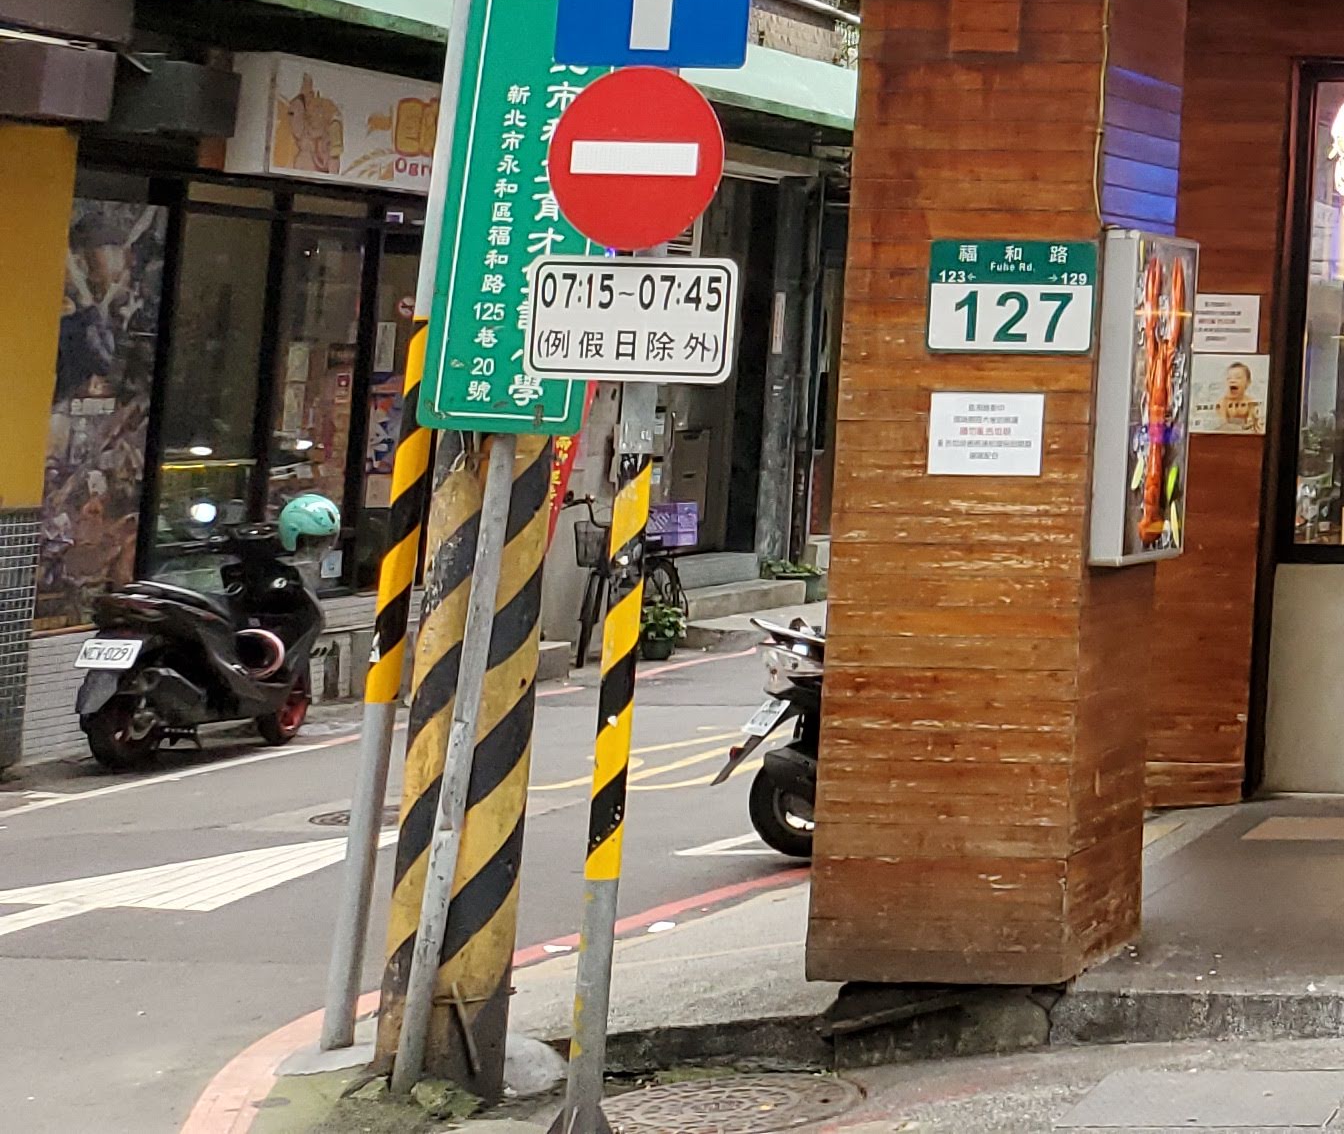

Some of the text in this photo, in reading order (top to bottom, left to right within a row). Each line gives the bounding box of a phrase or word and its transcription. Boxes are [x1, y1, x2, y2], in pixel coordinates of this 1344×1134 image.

[958, 244, 1068, 264] 福和路
[938, 270, 1087, 285] 123 129
[954, 290, 1074, 343] 127
[537, 329, 719, 362] (例假日除外)
